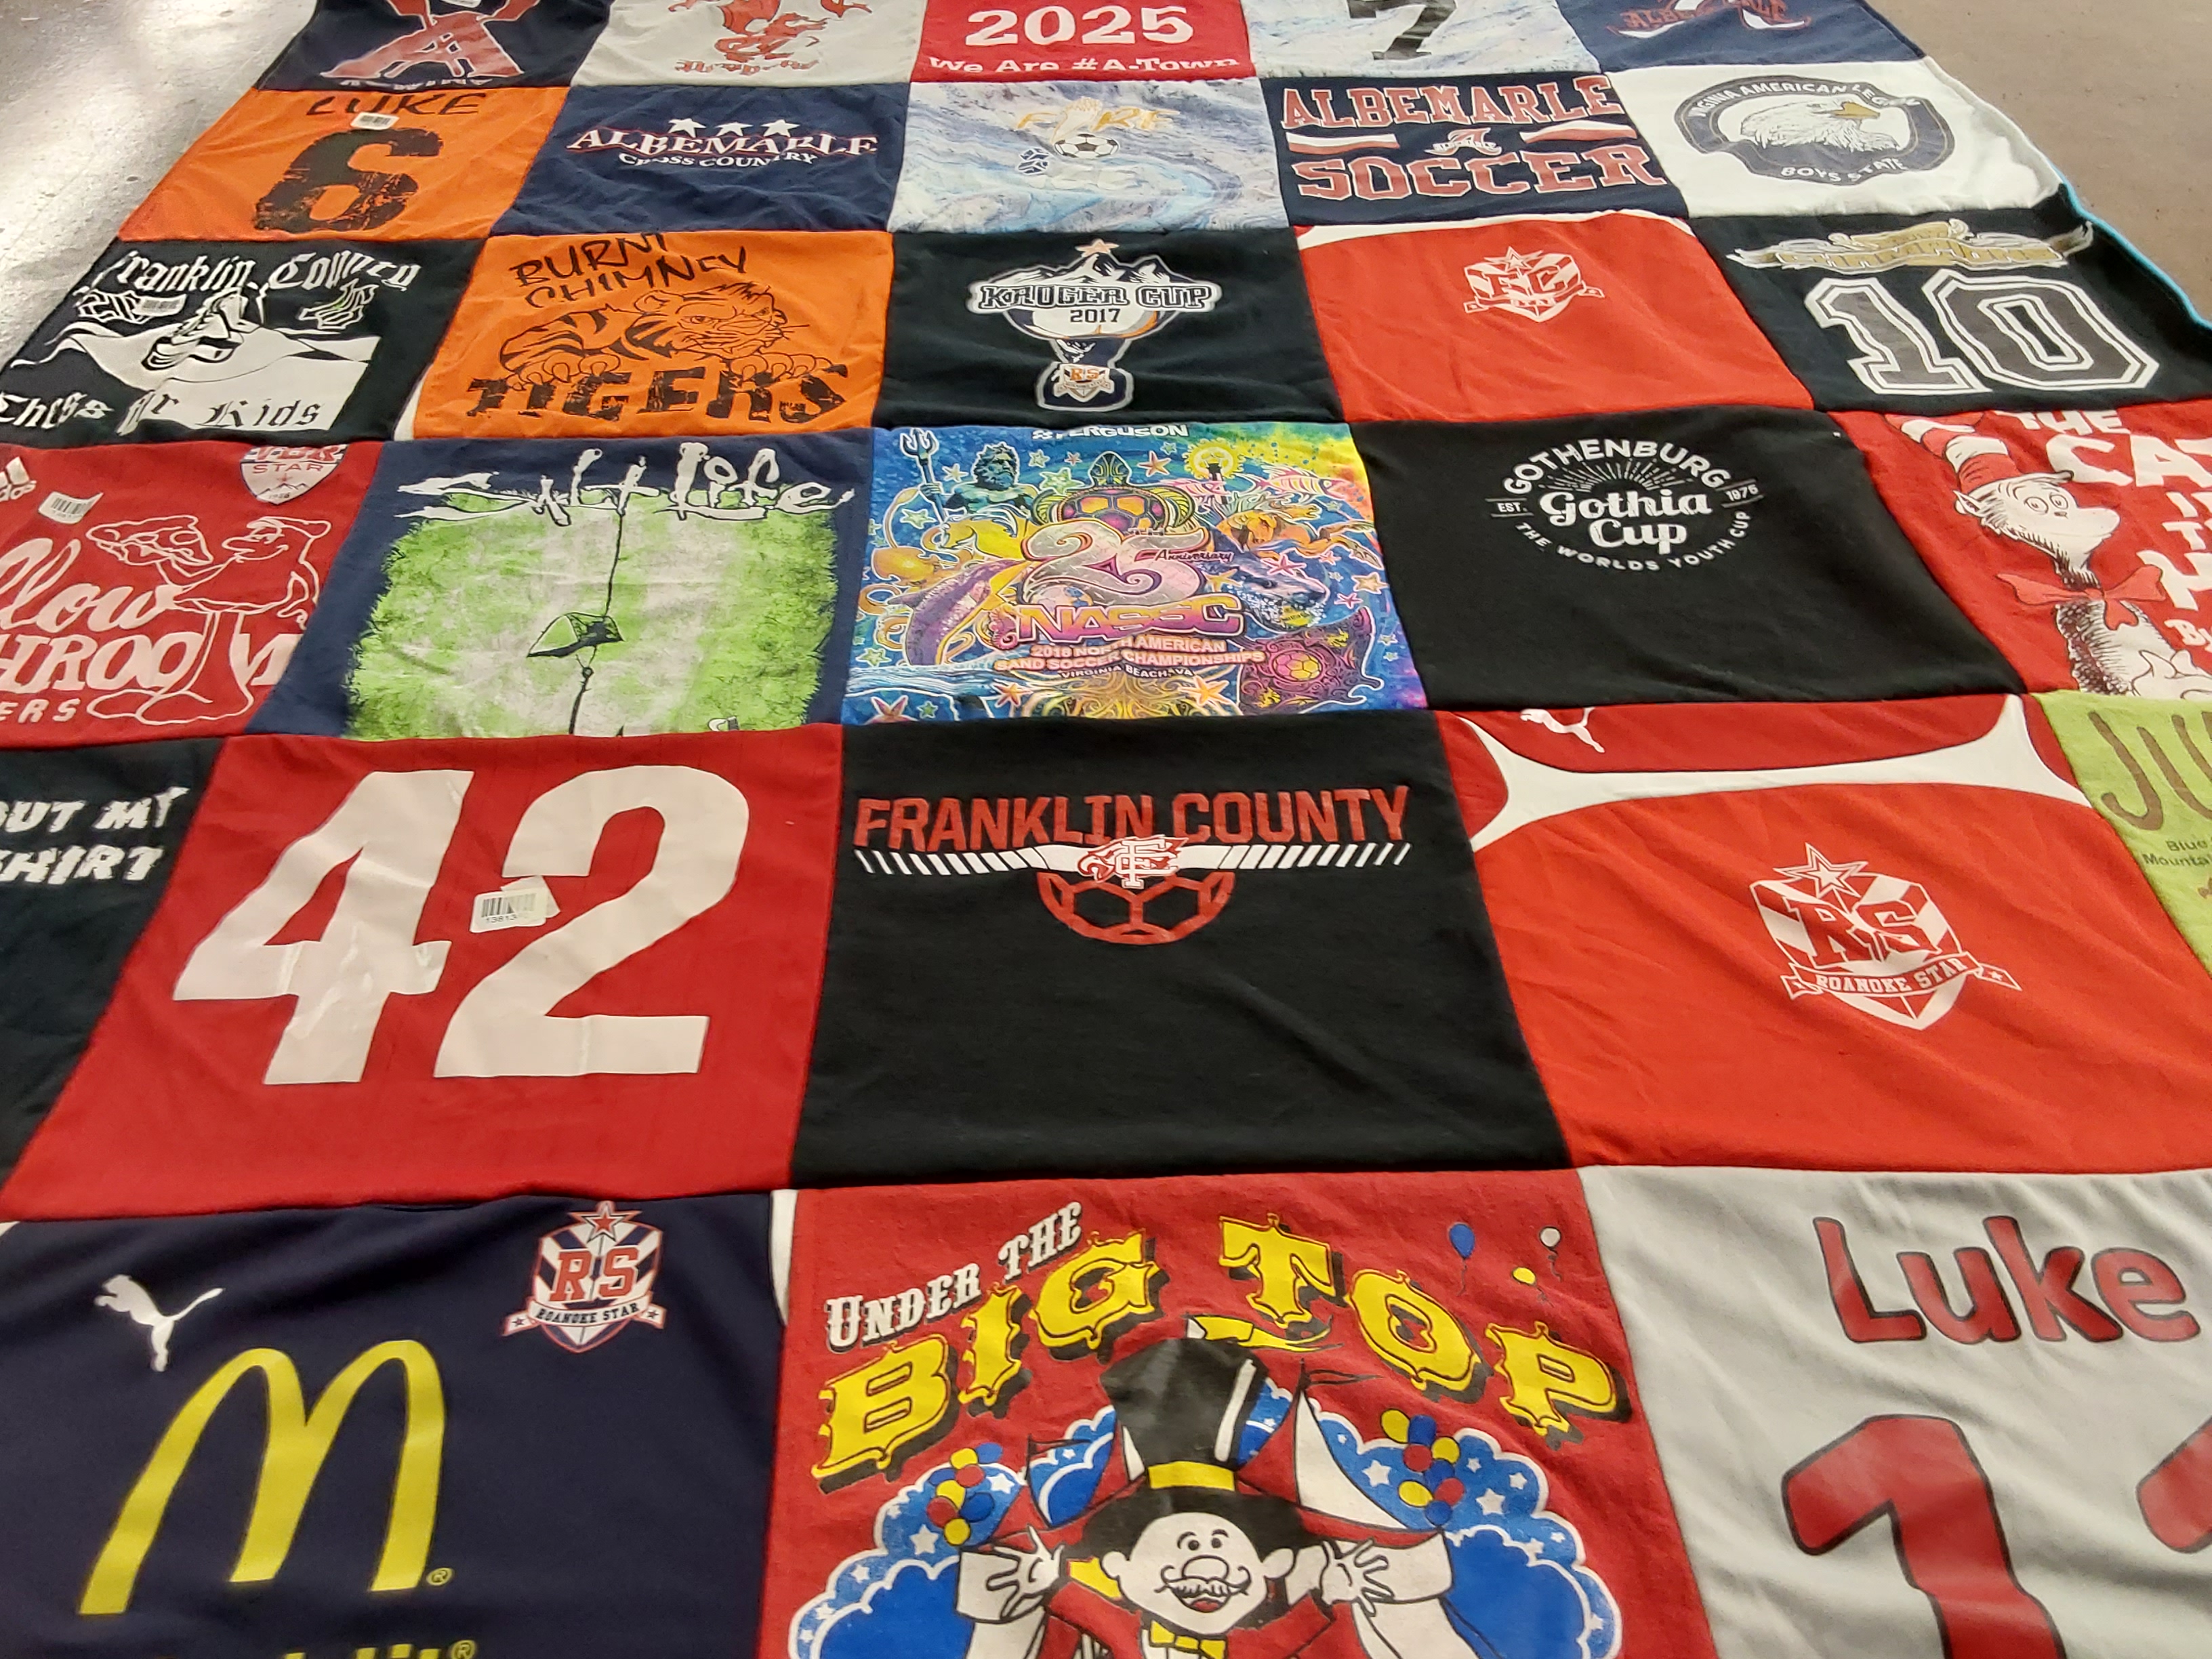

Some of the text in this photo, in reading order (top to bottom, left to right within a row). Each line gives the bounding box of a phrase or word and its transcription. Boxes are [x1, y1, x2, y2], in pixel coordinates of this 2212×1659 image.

[965, 5, 1193, 46] 2025
[928, 56, 984, 73] We
[1072, 56, 1240, 72] #A-Town
[306, 92, 487, 116] LUKE
[1281, 75, 1625, 128] ALBEMARLE
[1740, 82, 1849, 96] AMERICAN
[567, 129, 878, 157] ALBEMARLE
[253, 129, 445, 231] 6
[1290, 144, 1667, 201] SOCCER
[1780, 166, 1841, 182] BOYS
[979, 285, 1212, 309] KRUGER CUP
[1069, 308, 1120, 323] 2017
[1804, 269, 2160, 394] 10
[252, 464, 324, 474] STAR
[1504, 438, 1731, 494] GOTHENBURG
[1540, 489, 1712, 527] Gothia
[1515, 521, 1553, 548] THE
[1668, 538, 1736, 569] YOUTH
[1729, 511, 1752, 538] CUP
[1589, 518, 1687, 554] Cup
[994, 650, 1265, 670] SAND SOCCER CHAMPIONSHIPS
[1033, 646, 1071, 657] 2018
[1134, 636, 1225, 652] AMERICAN
[854, 785, 1410, 852] FRANKLIN COUNTY
[2165, 841, 2207, 851] Blue
[173, 766, 749, 1084] 42
[1814, 958, 1968, 994] ROANOKE STAR
[550, 1247, 638, 1301] RS
[825, 1201, 1084, 1353] UNDER THE
[1812, 1214, 2201, 1345] Luke
[535, 1303, 639, 1324] ROANOKE STAR
[811, 1212, 1629, 1488] BIG TOP
